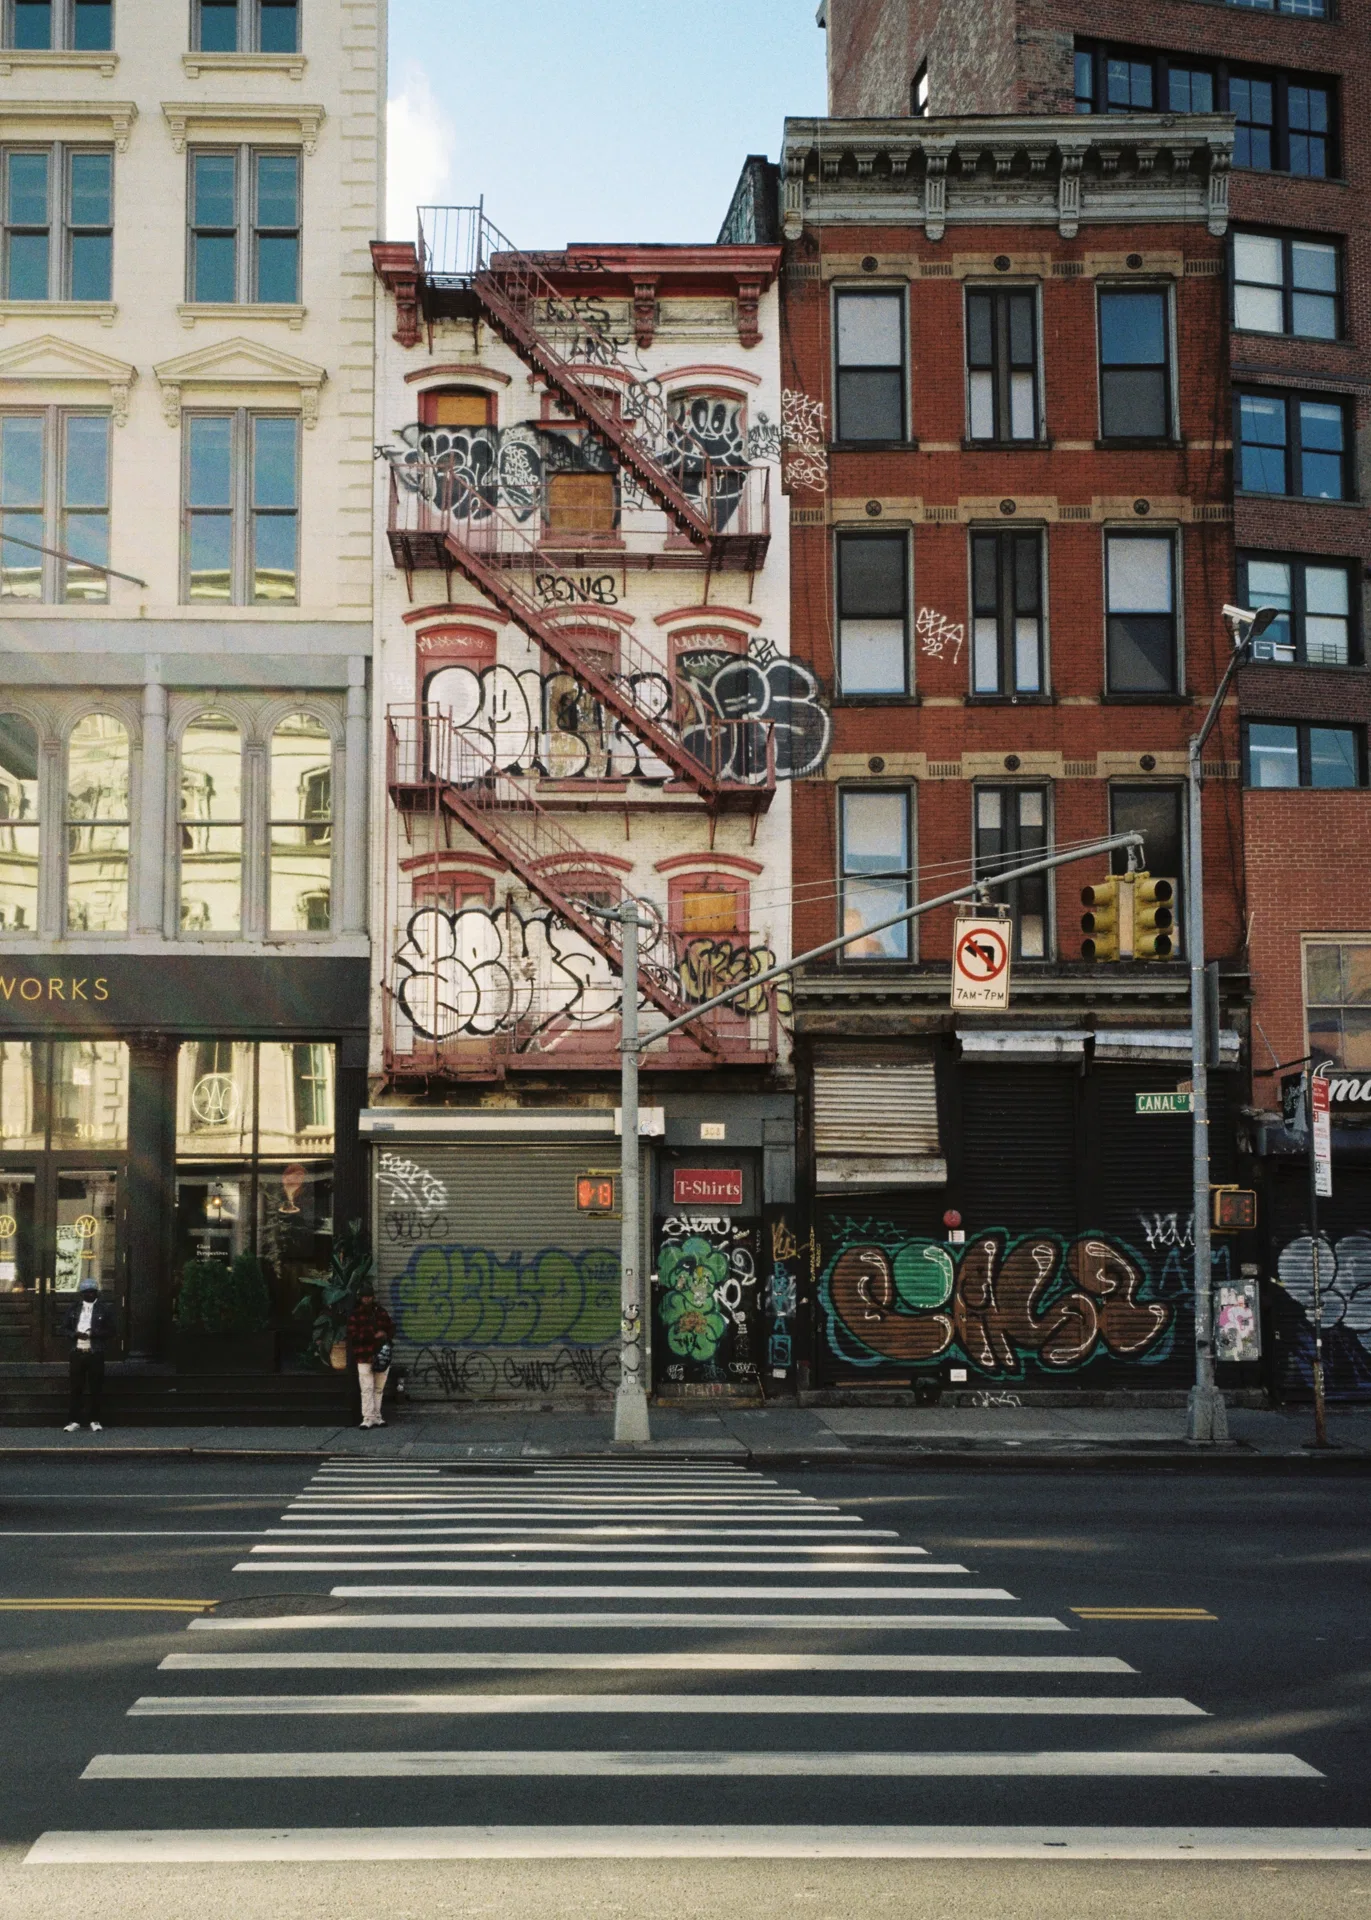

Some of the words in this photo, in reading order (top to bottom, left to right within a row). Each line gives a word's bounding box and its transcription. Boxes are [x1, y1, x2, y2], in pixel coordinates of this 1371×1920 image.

[1138, 1095, 1177, 1111] CANAL
[1177, 1096, 1186, 1104] ST
[676, 1180, 740, 1196] T-Shirts
